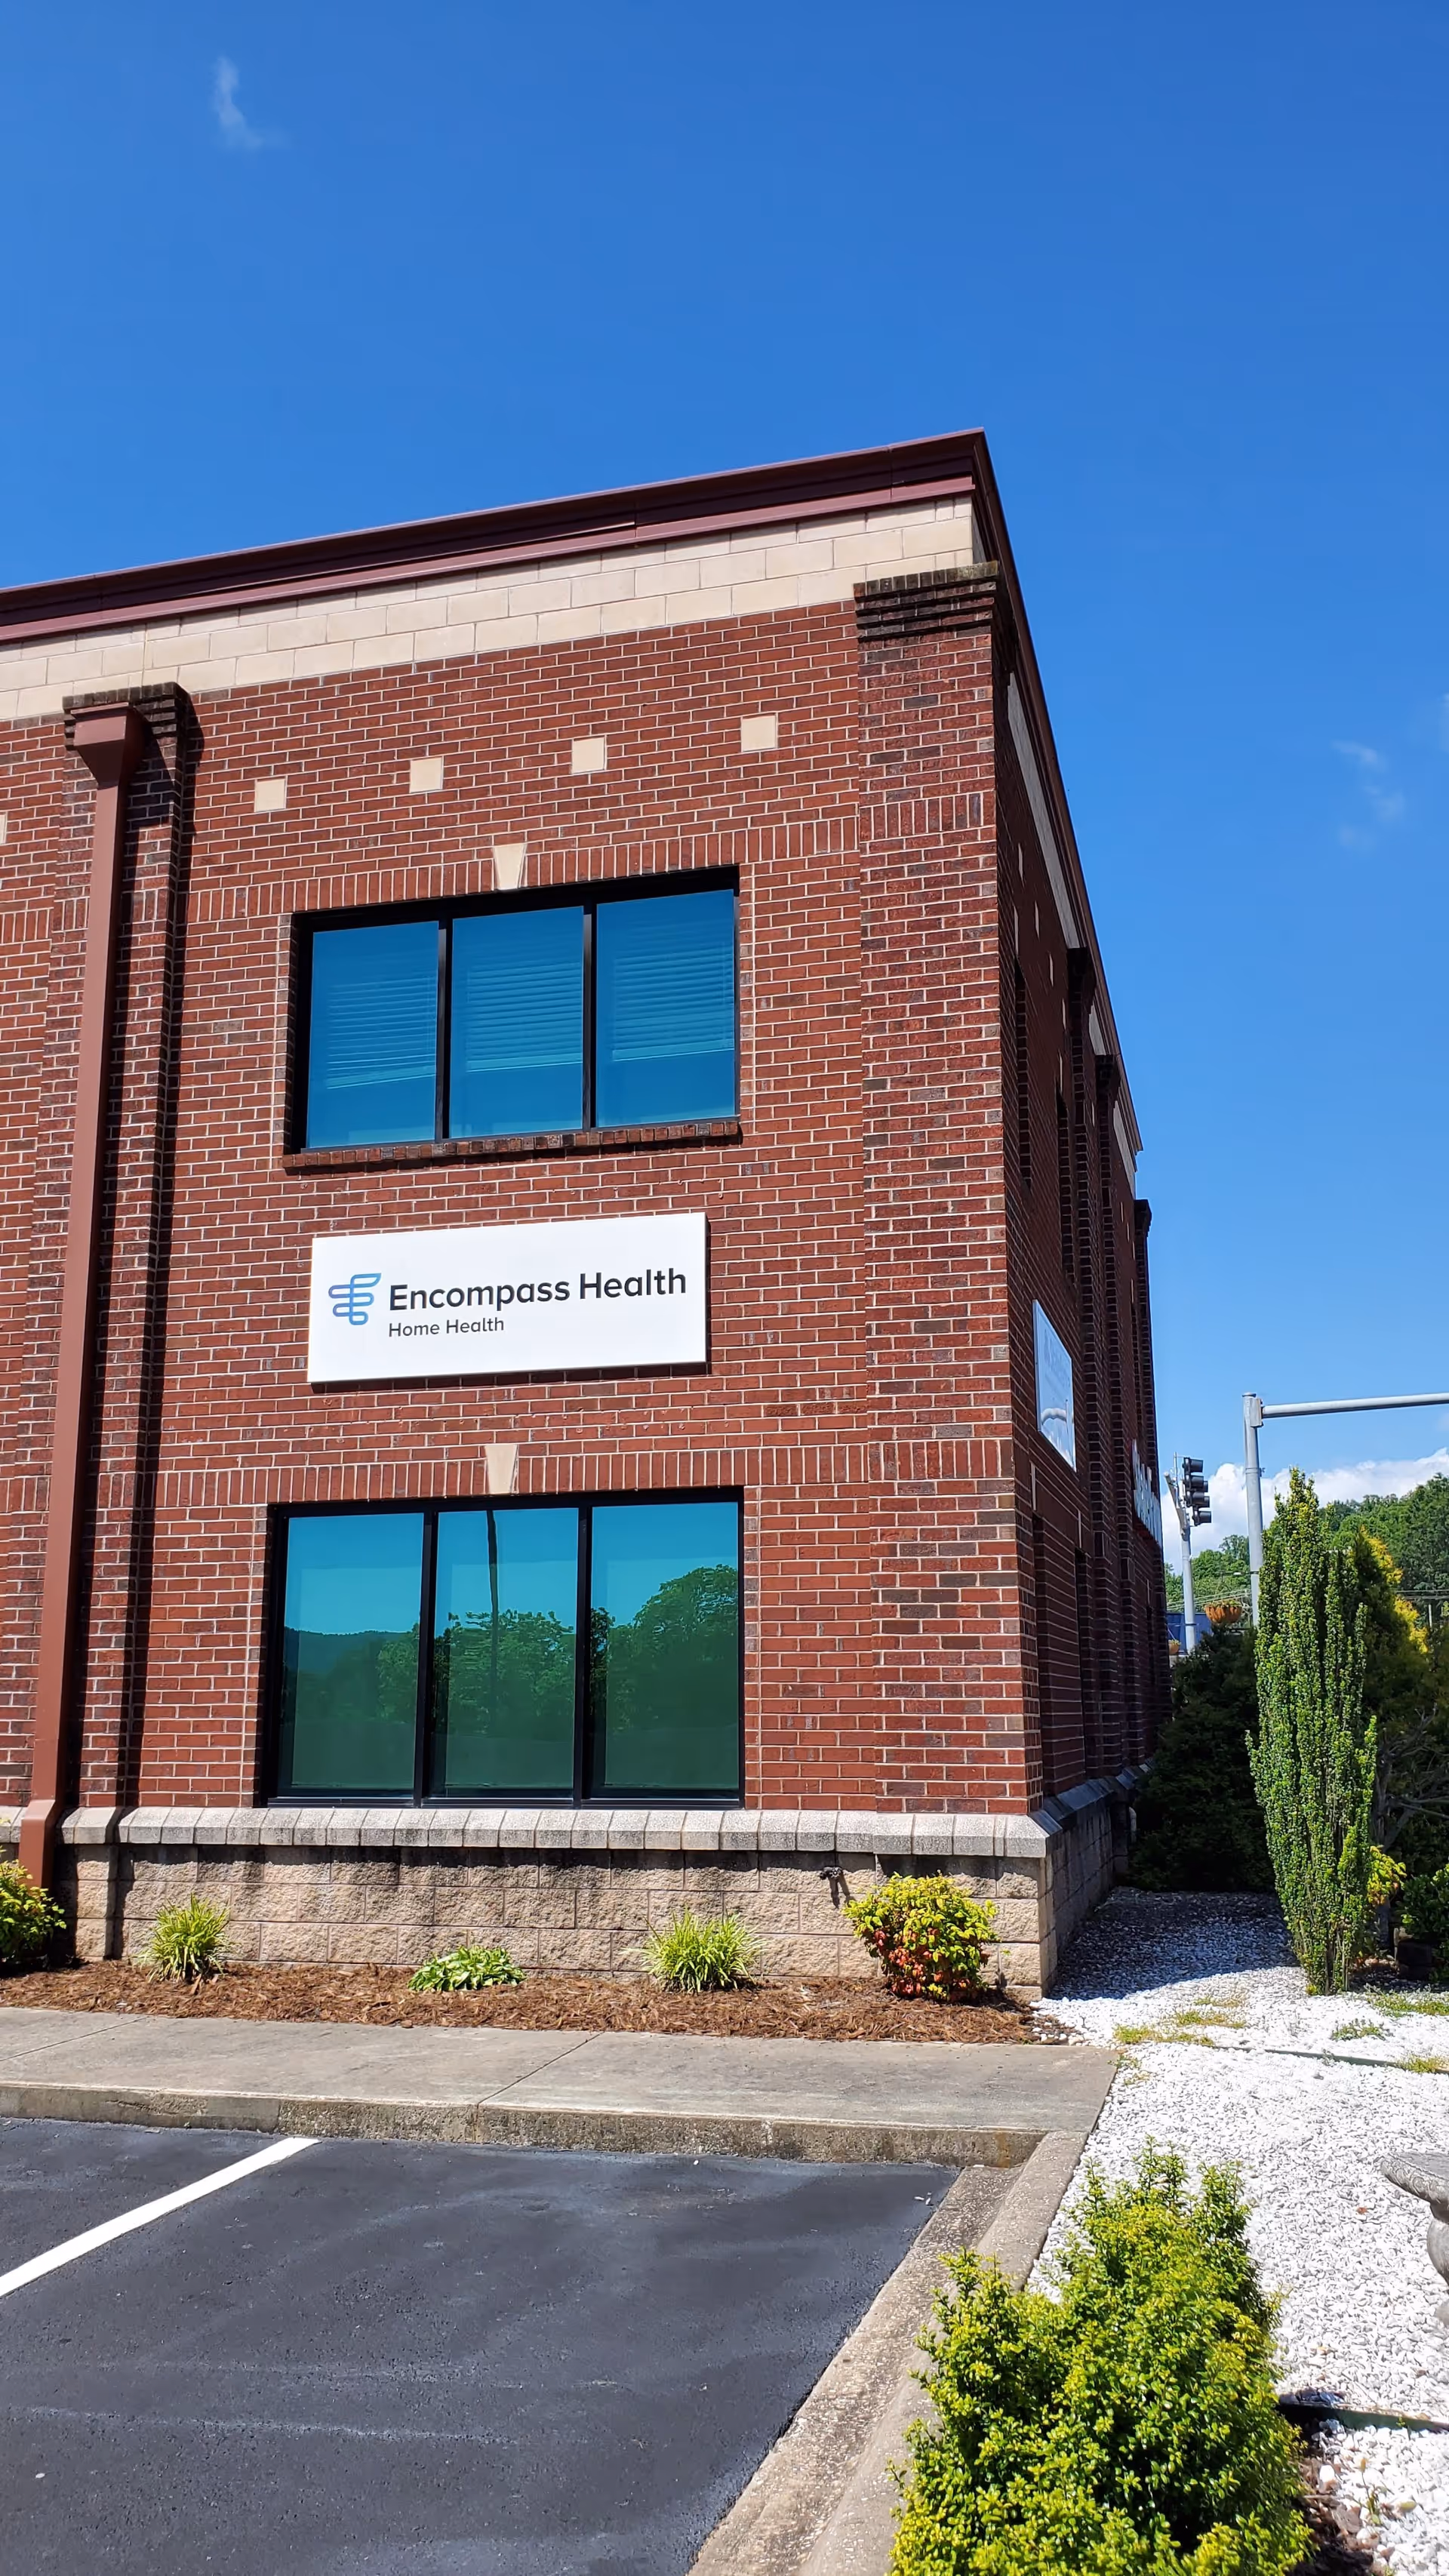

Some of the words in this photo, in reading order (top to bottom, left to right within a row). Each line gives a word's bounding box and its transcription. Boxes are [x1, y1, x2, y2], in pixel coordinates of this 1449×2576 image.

[389, 1280, 571, 1312] Encompass
[579, 1267, 687, 1300] Health
[388, 1322, 440, 1337] Home
[445, 1316, 505, 1334] Health
